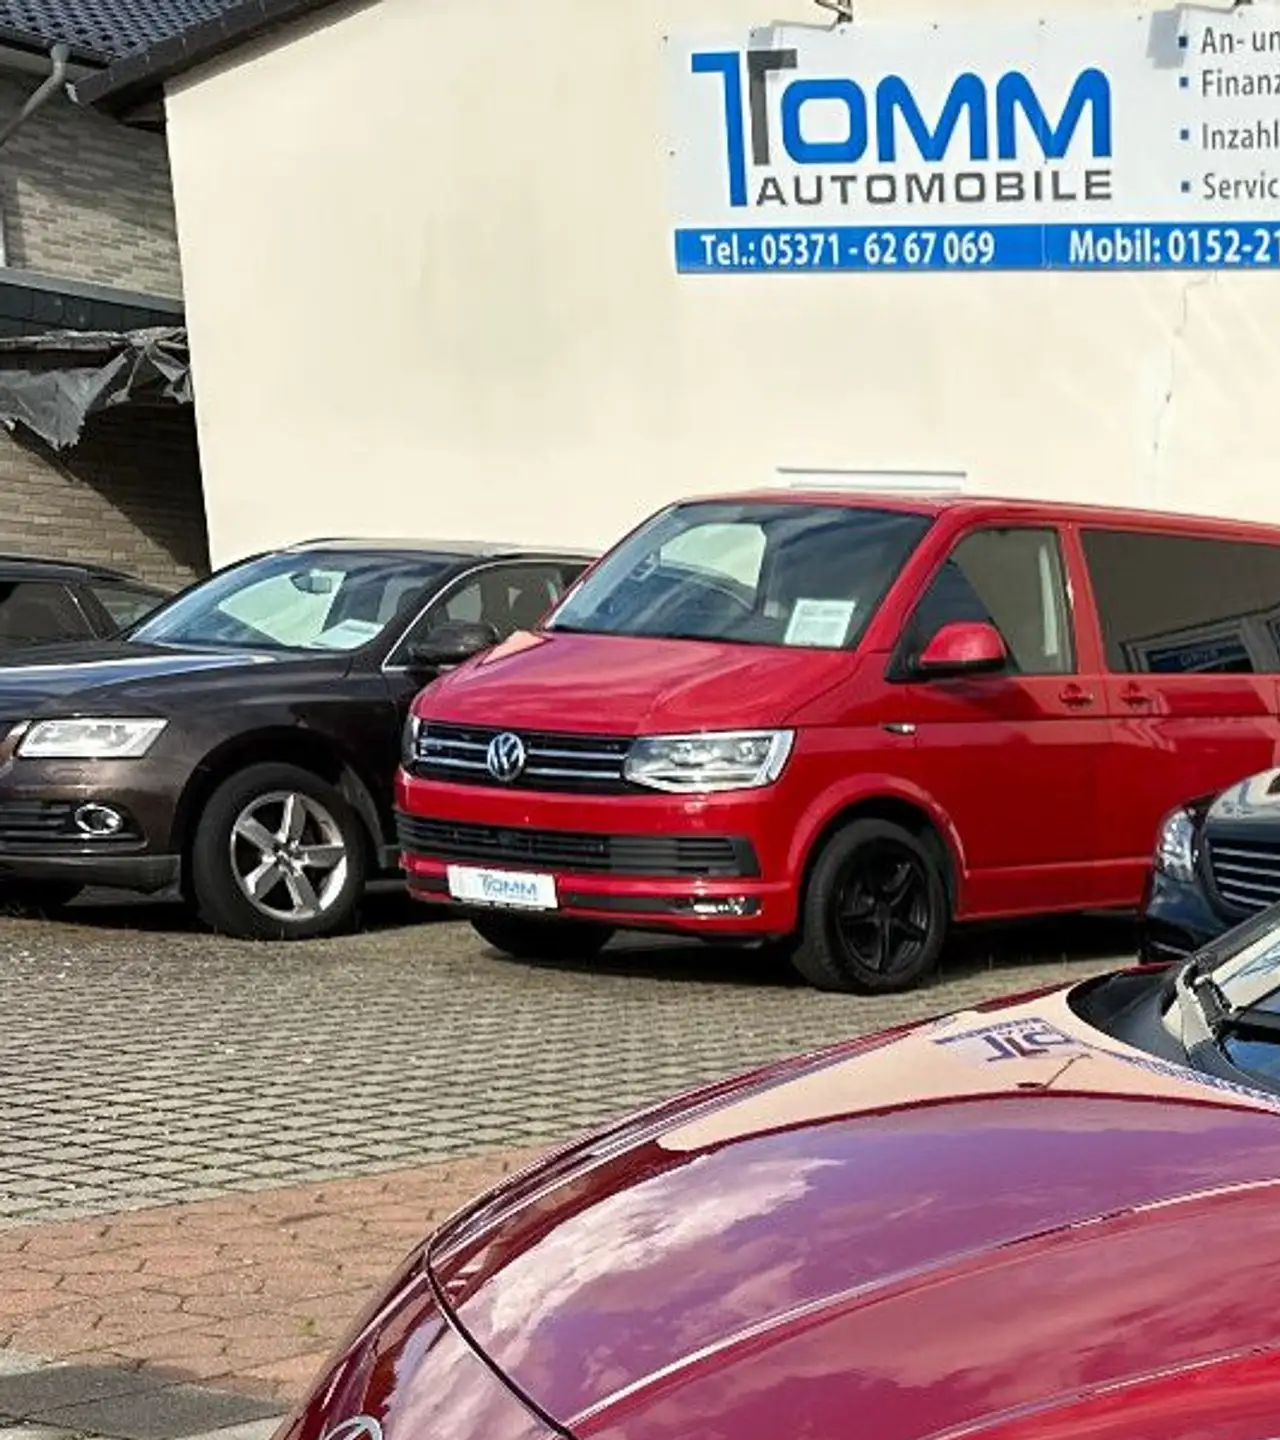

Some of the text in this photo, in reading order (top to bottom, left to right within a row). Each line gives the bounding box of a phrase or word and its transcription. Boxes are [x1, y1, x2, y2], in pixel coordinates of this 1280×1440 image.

[1200, 26, 1244, 54] An-
[755, 169, 1113, 207] AUTOMOBILE
[760, 232, 840, 265] 05371
[863, 231, 898, 264] 62
[903, 231, 937, 264] 67
[943, 230, 996, 264] 069
[1068, 226, 1163, 264] Mobil:
